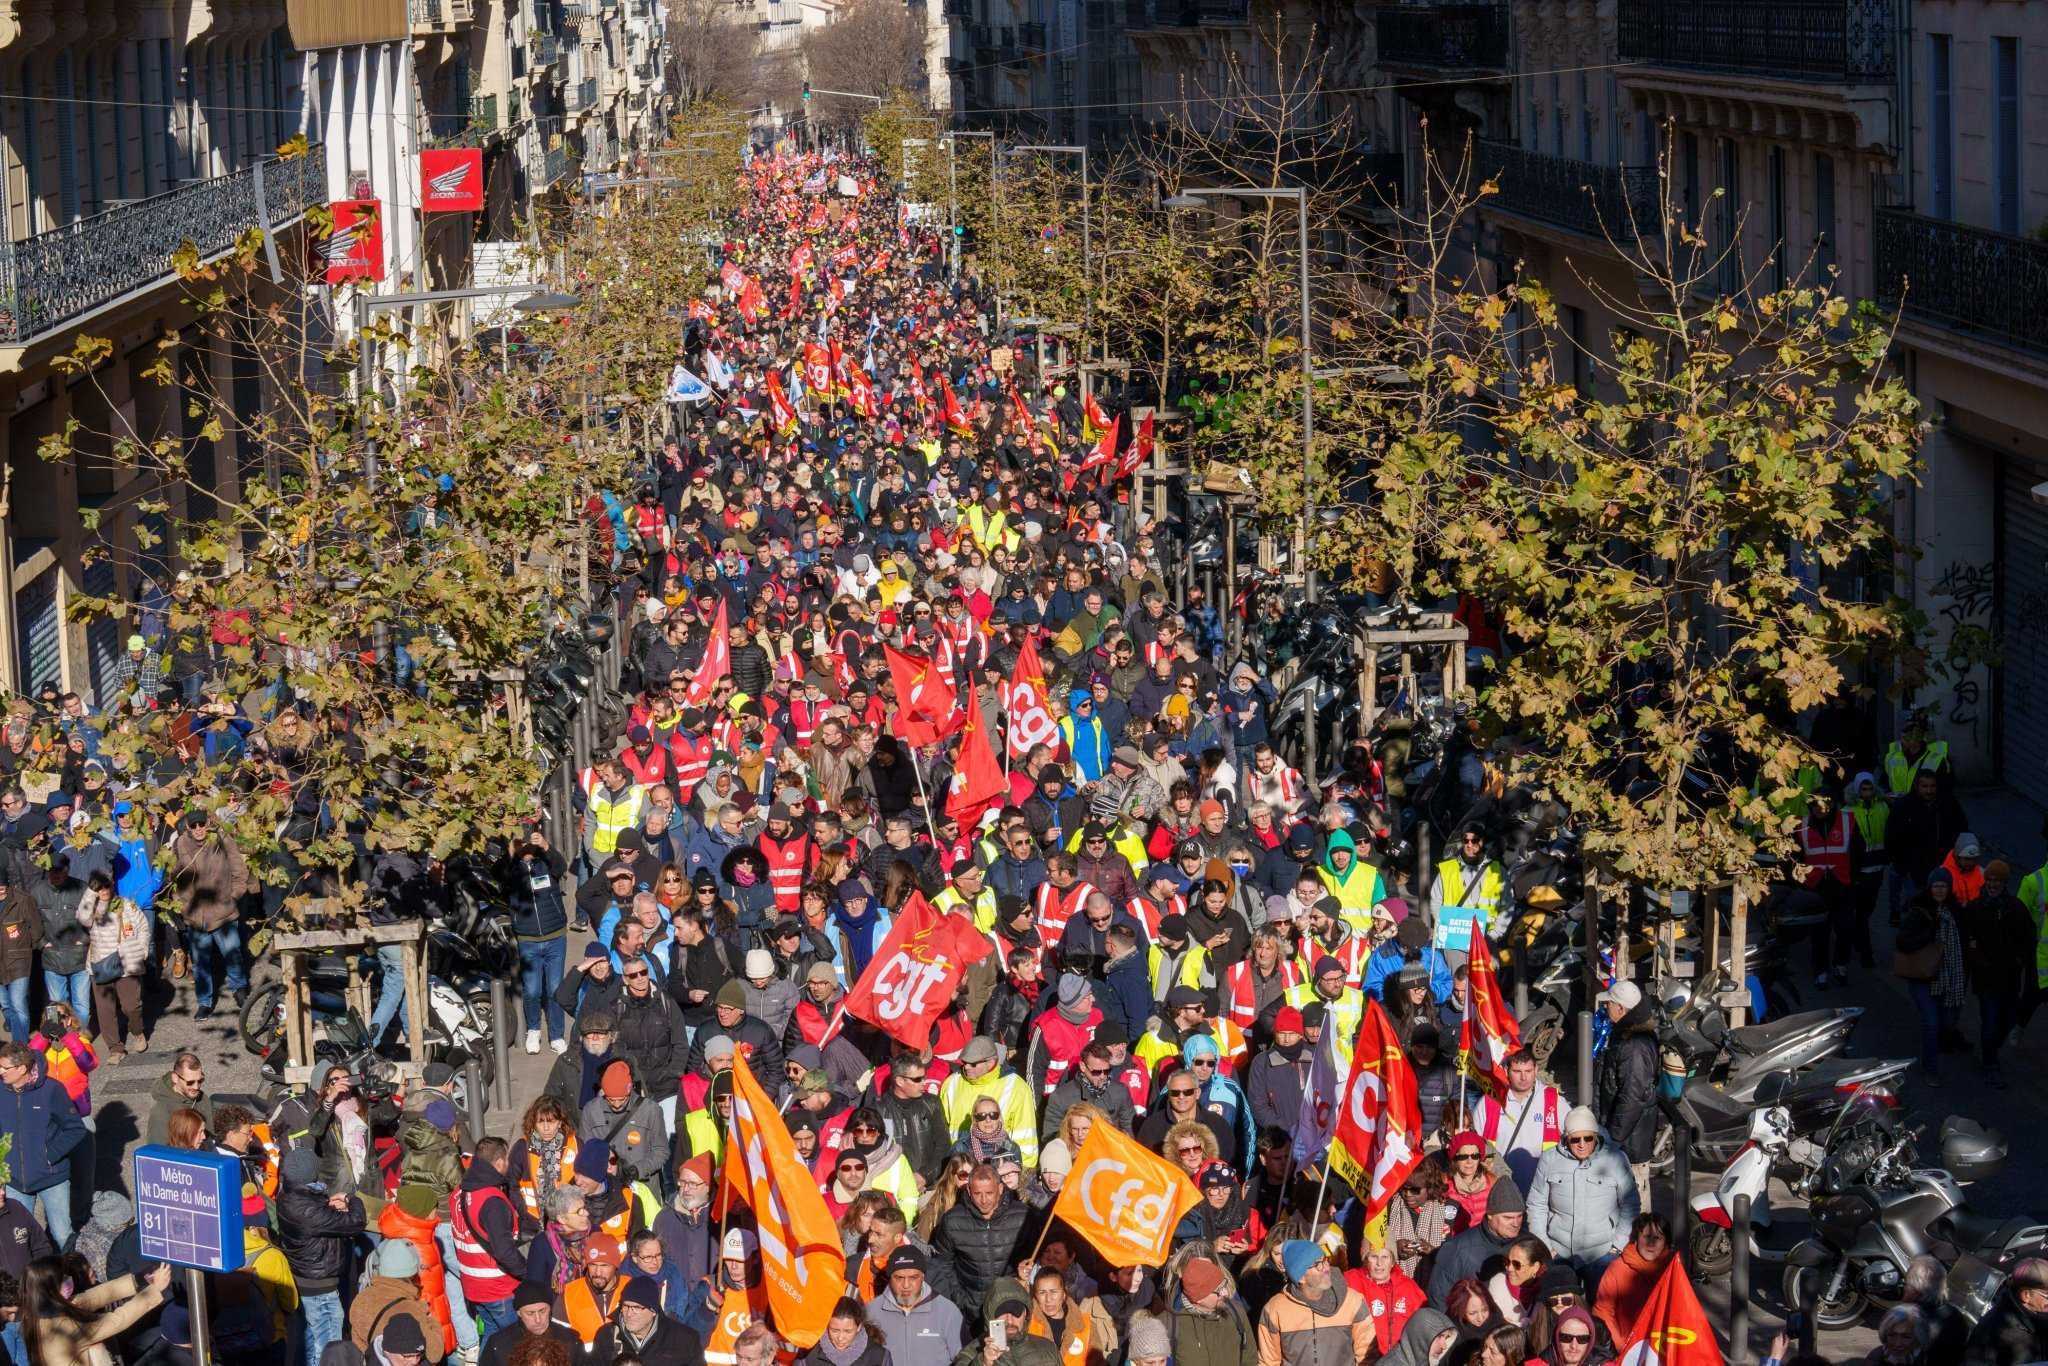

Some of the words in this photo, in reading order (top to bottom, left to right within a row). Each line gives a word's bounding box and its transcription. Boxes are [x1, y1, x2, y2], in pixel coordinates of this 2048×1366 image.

[429, 191, 473, 199] HONDA
[161, 1167, 193, 1186] Métro
[141, 1182, 152, 1197] Nt
[153, 1184, 179, 1202] Dame
[181, 1189, 193, 1204] du
[194, 1191, 217, 1209] Mont
[144, 1212, 161, 1230] 81
